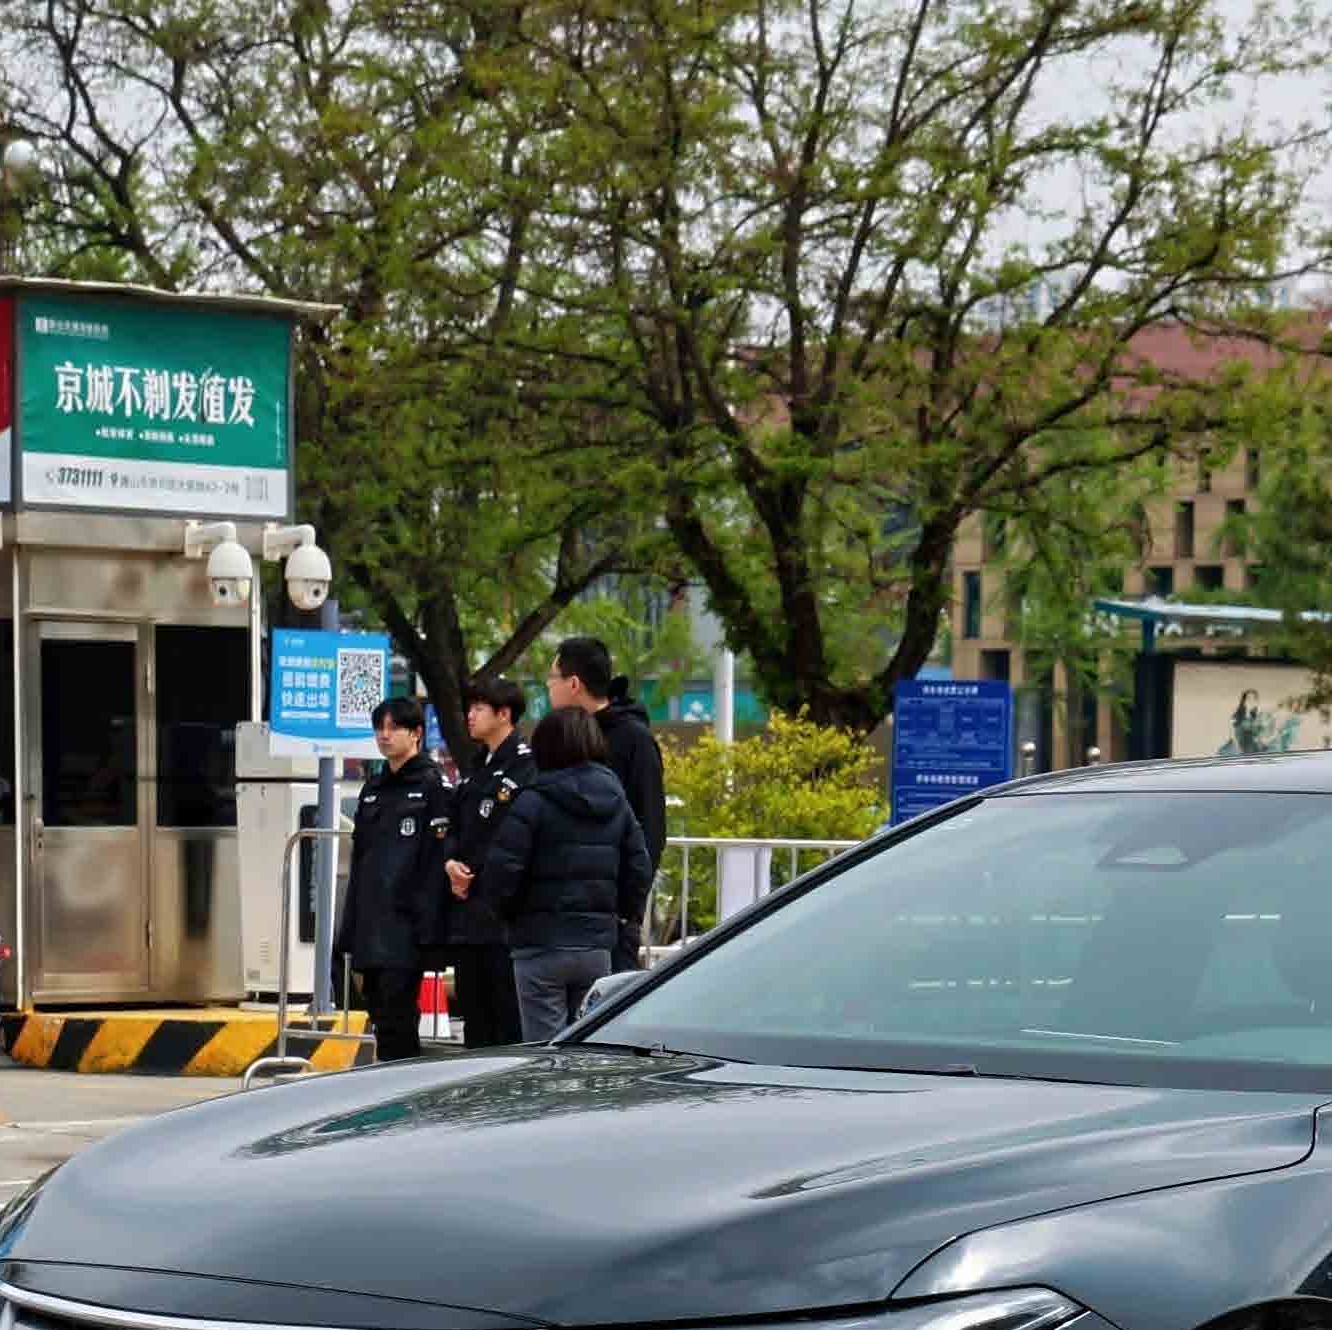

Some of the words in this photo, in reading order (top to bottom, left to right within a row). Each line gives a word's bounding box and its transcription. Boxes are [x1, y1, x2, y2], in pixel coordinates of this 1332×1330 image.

[54, 360, 256, 427] 京城不剃发植发
